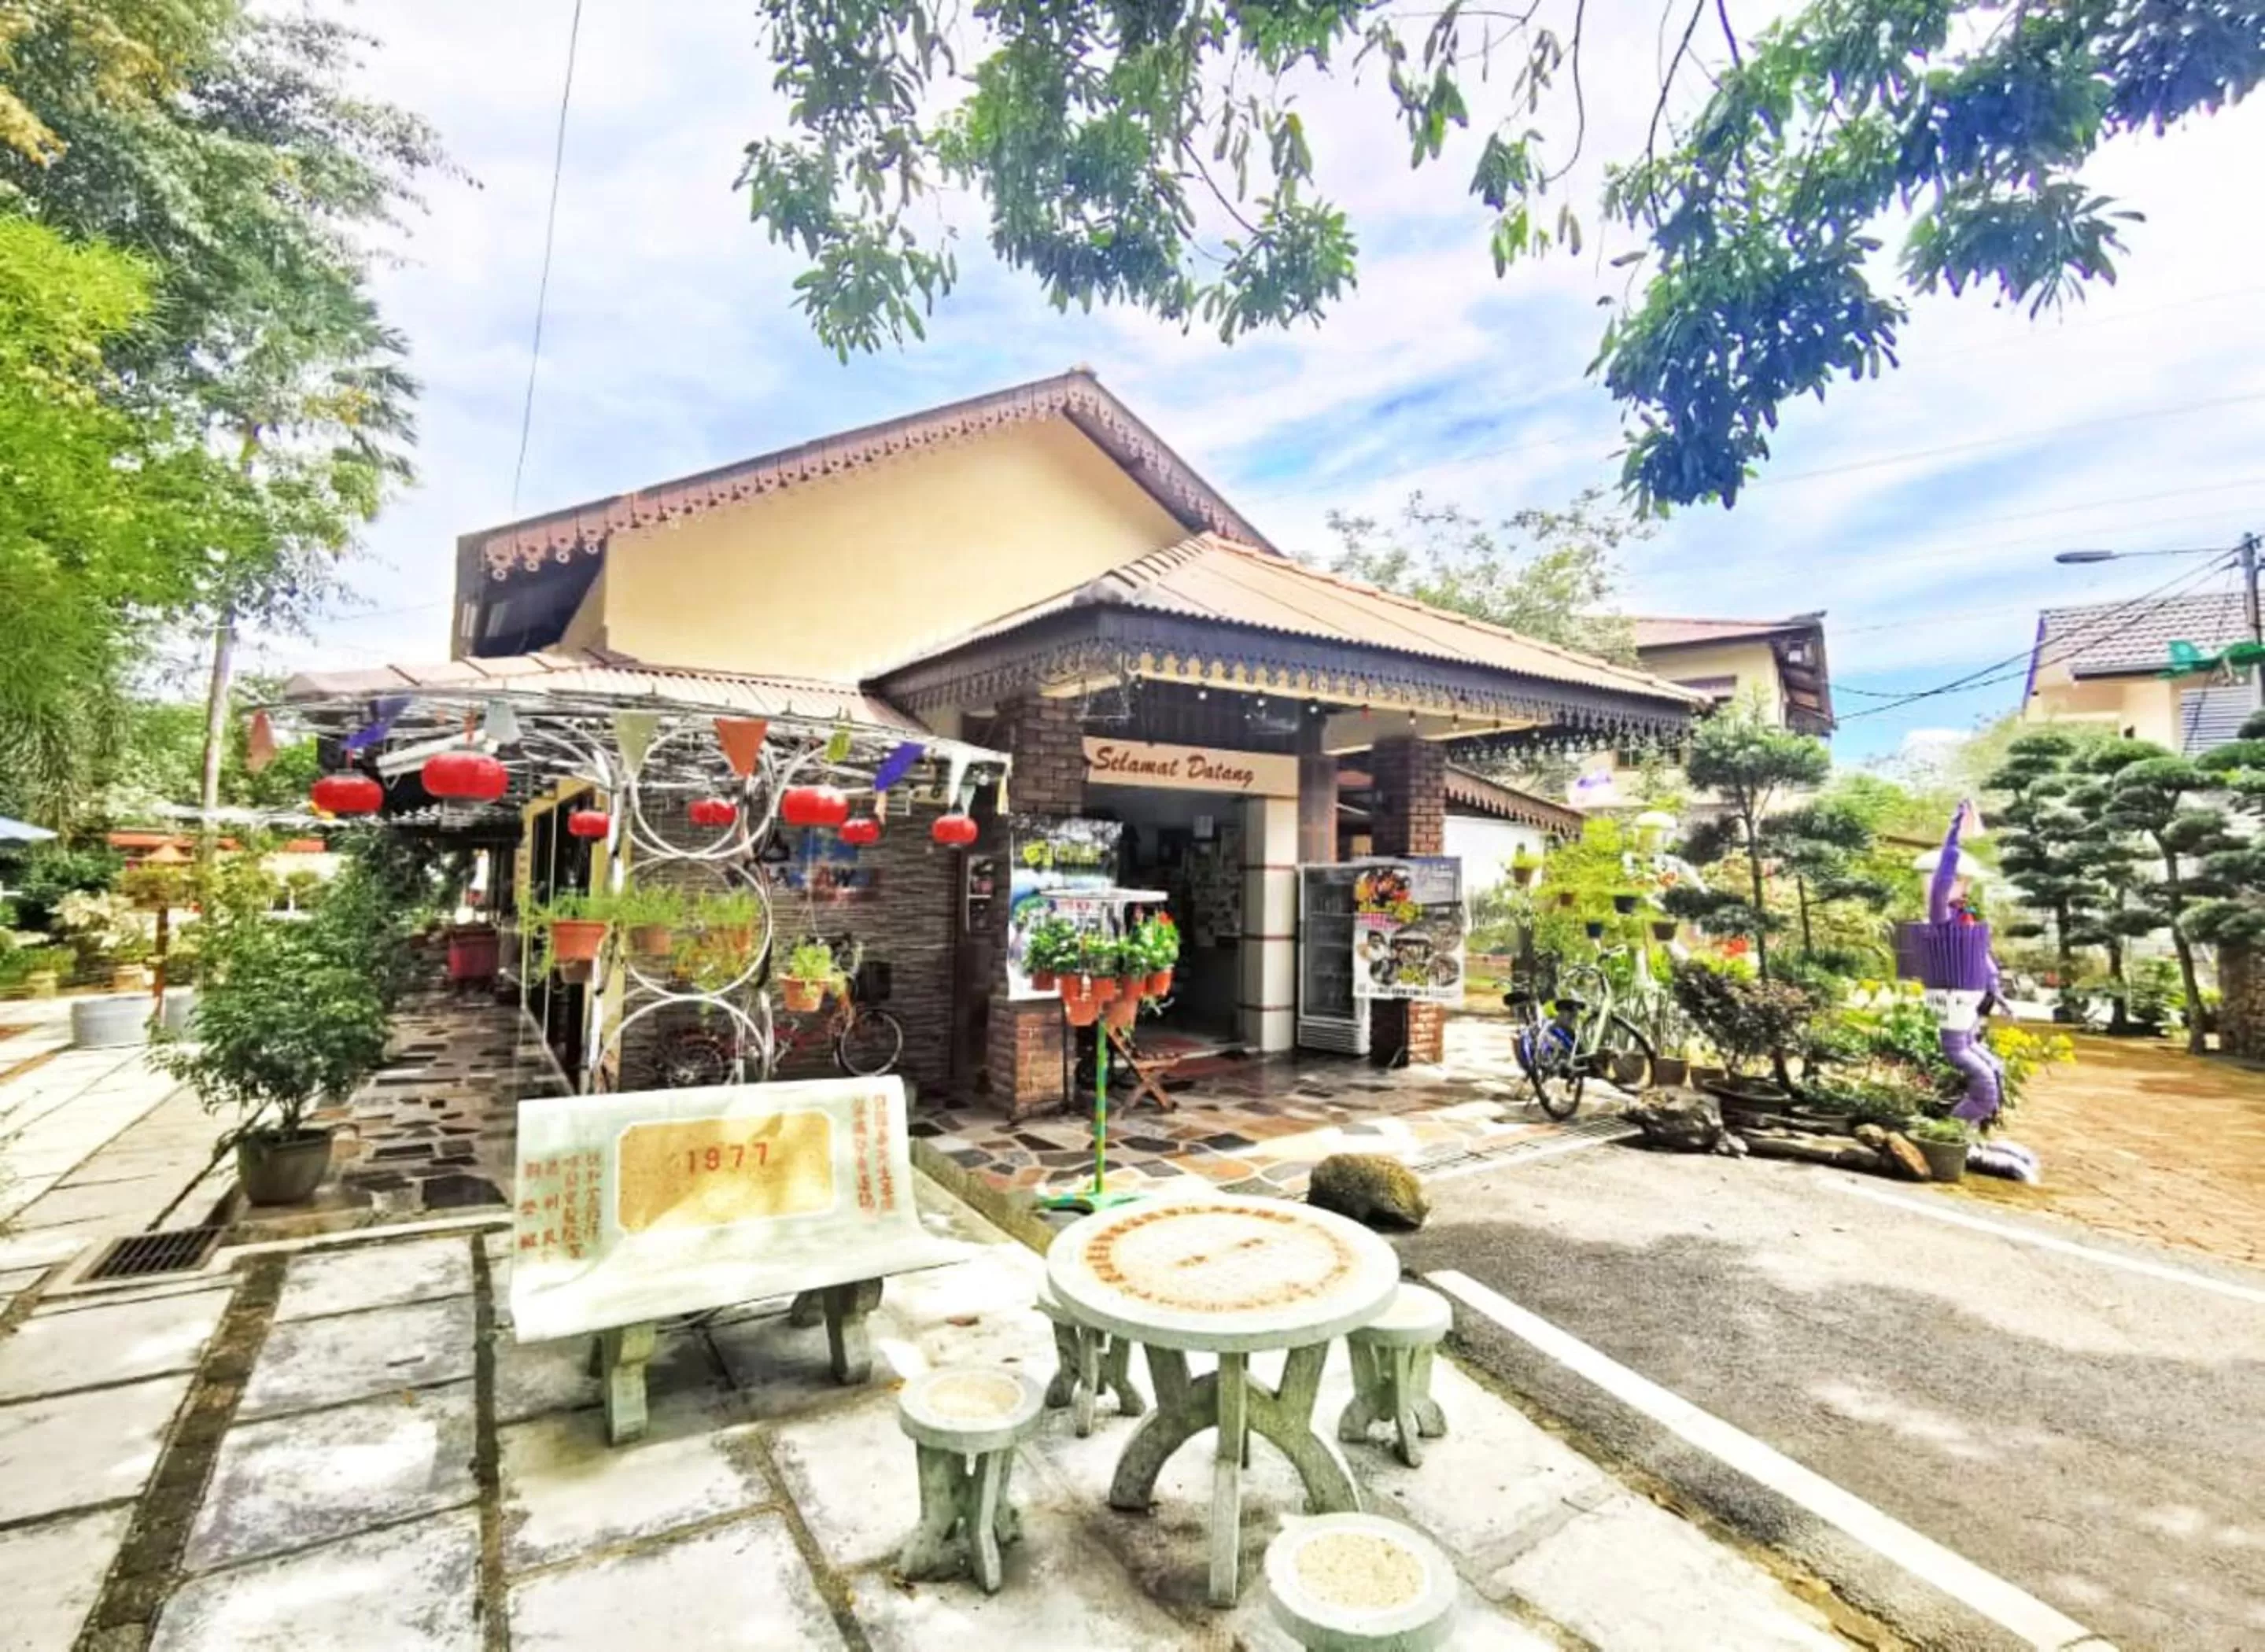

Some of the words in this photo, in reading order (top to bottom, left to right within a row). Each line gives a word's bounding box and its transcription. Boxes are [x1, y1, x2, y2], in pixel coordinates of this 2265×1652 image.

[1093, 746, 1179, 776] Selamat
[1186, 754, 1255, 787] Datang
[685, 1141, 770, 1174] 1977
